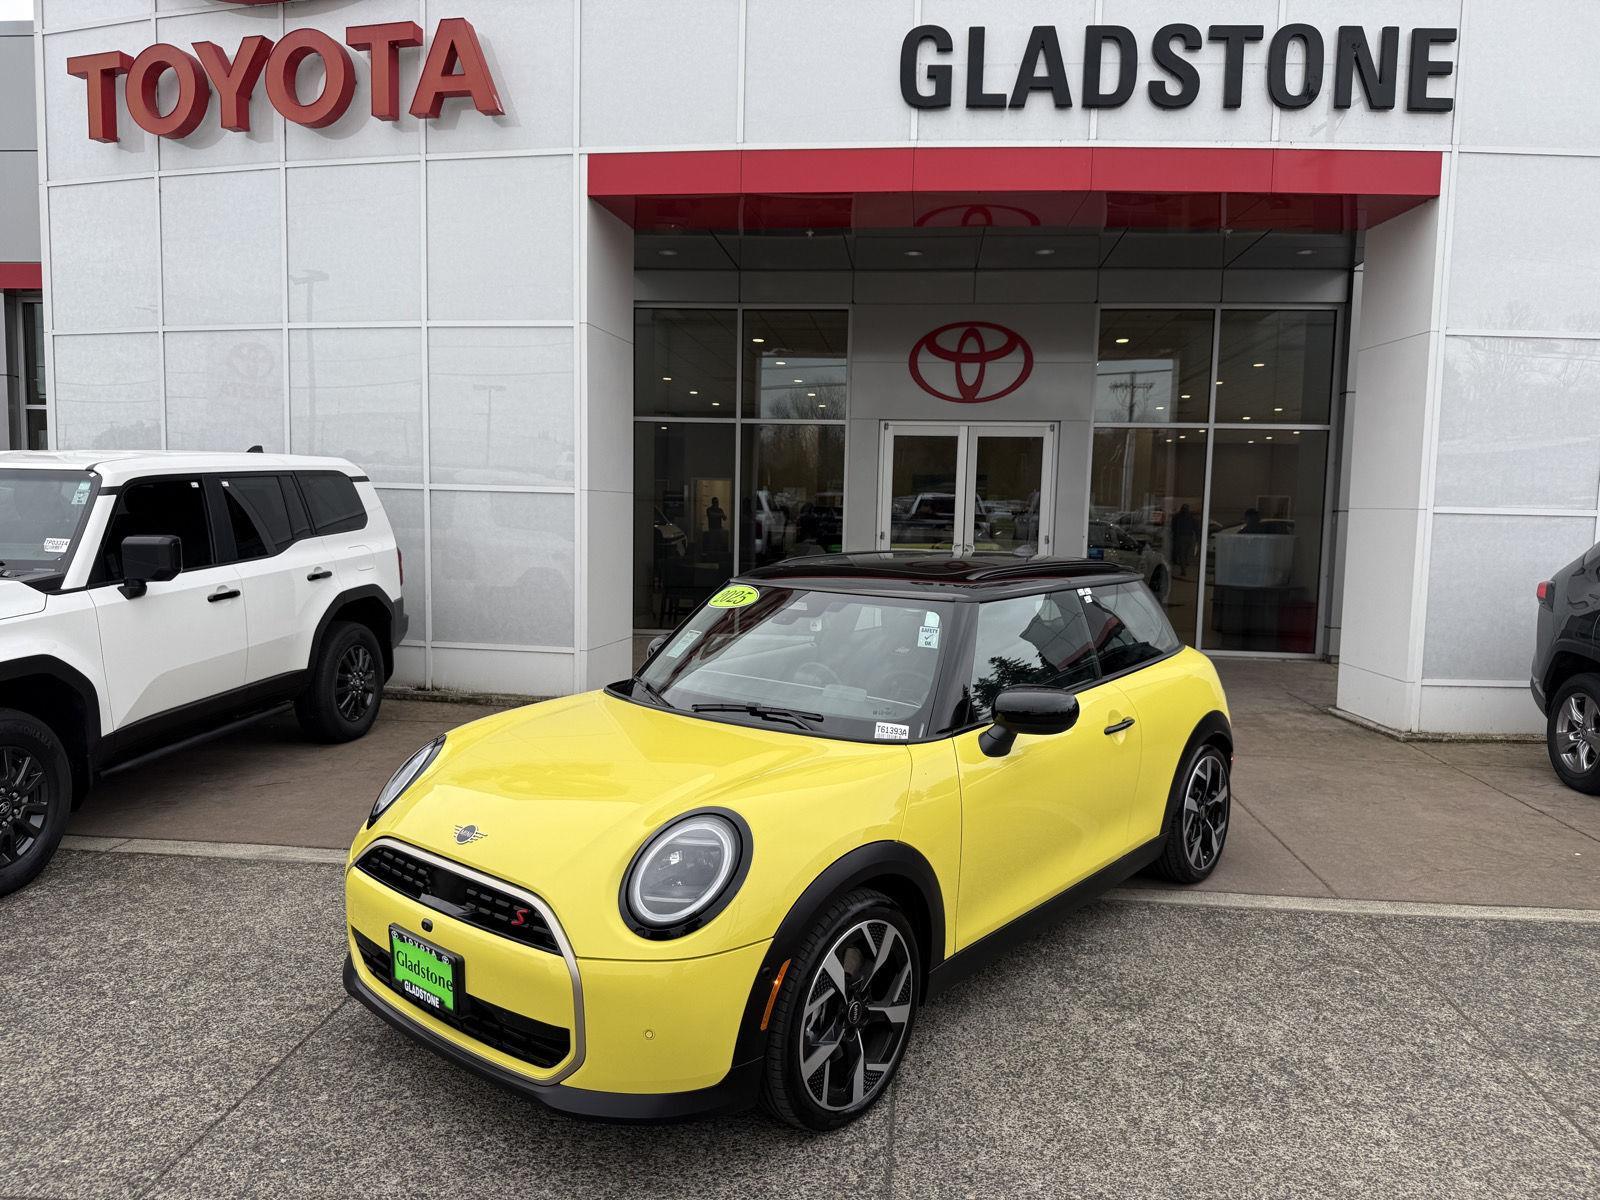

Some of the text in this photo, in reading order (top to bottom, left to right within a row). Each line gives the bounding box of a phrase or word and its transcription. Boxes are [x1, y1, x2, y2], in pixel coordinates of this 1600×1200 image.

[900, 23, 1457, 111] GLADSTONE
[67, 18, 505, 143] TOYOTA
[712, 589, 754, 604] 2025
[877, 725, 907, 737] T61393A
[511, 908, 529, 926] S
[403, 936, 437, 958] TOYOTA
[396, 950, 453, 992] Gladstone
[404, 980, 440, 1009] GLADSTONE
